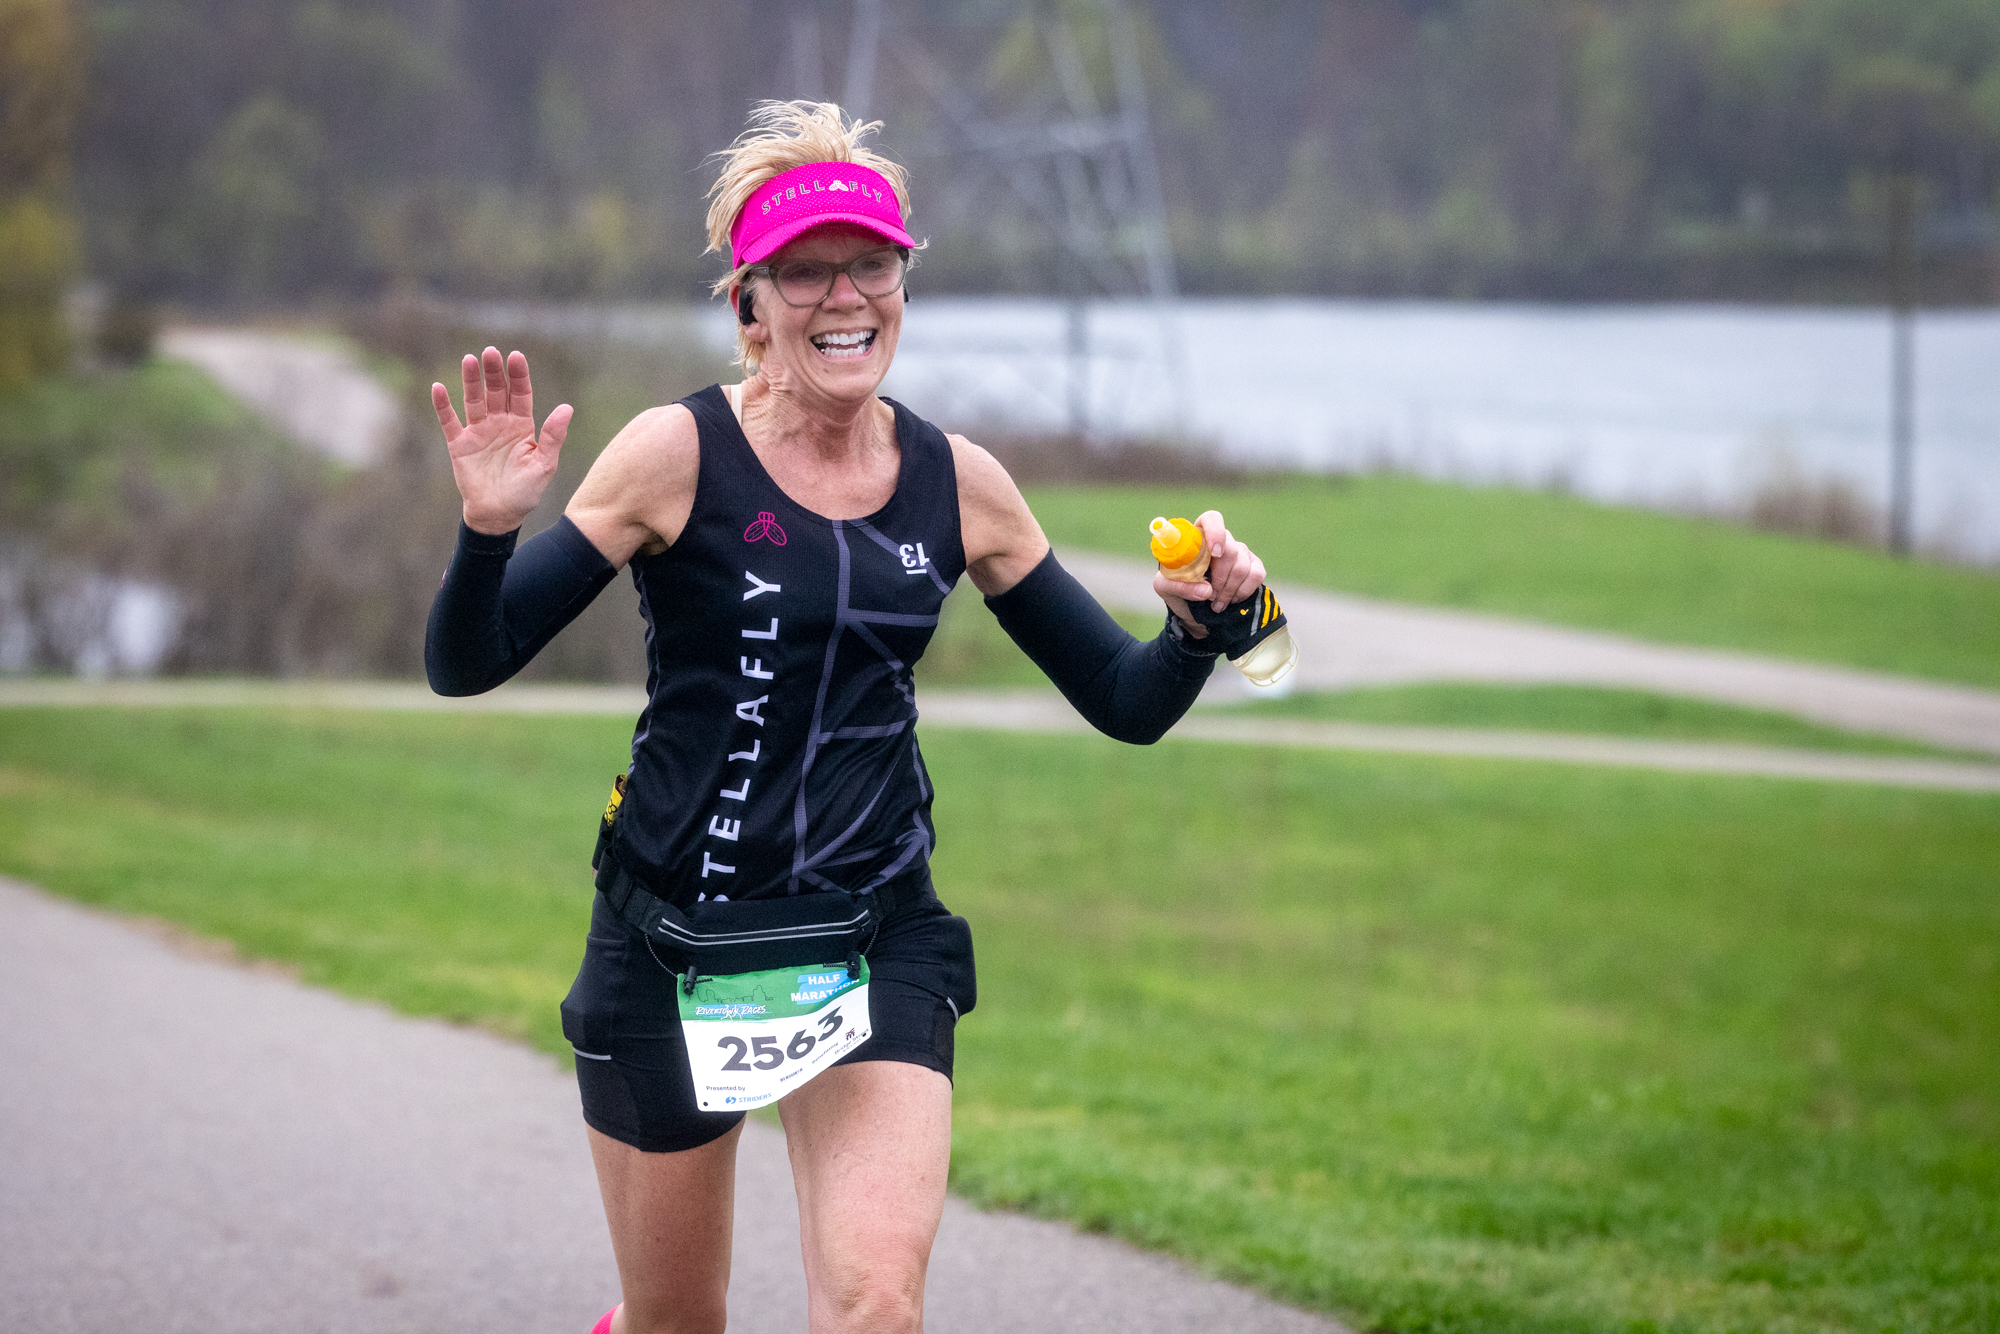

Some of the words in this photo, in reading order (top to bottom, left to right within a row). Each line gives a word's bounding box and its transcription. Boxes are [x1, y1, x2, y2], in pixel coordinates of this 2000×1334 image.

[899, 542, 930, 569] 13
[790, 978, 860, 1002] MARATHON
[807, 973, 841, 986] HALF
[717, 1006, 844, 1072] 2563
[738, 1092, 772, 1103] STRIDERS
